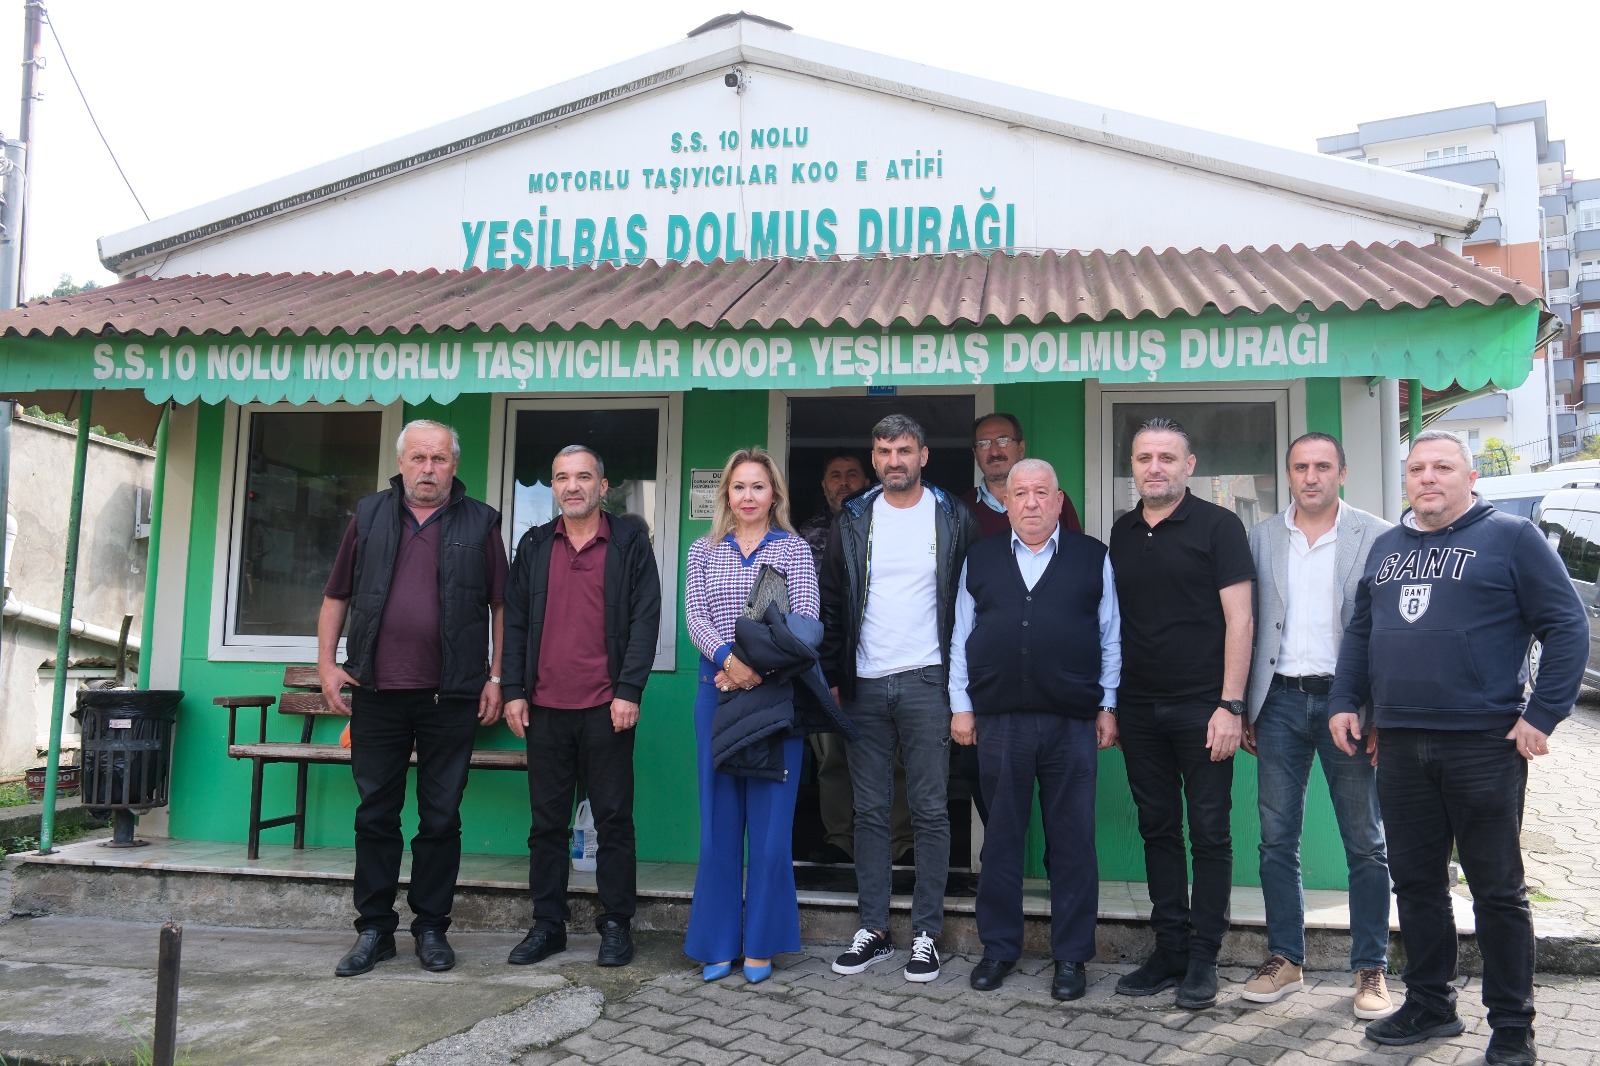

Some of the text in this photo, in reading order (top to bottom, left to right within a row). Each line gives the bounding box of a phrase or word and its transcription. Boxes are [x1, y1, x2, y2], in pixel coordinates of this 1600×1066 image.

[671, 126, 808, 153] S.S. 10 NOLU
[528, 169, 630, 194] MOTORLU
[643, 164, 777, 194] TAŞIYICILAR
[886, 149, 942, 180] ATİFİ
[858, 186, 1015, 256] DURAĞI
[207, 344, 291, 381] NOLU
[304, 343, 461, 380] MOTORLU
[473, 339, 680, 390] TAŞIYICILAR
[693, 337, 796, 378] KOOP.
[809, 327, 989, 386] YEŞİLBAŞ
[1003, 329, 1167, 382] DOLMUŞ
[1180, 312, 1329, 369] DURAĞI
[1375, 547, 1476, 586] GANT
[1404, 588, 1428, 597] GANT
